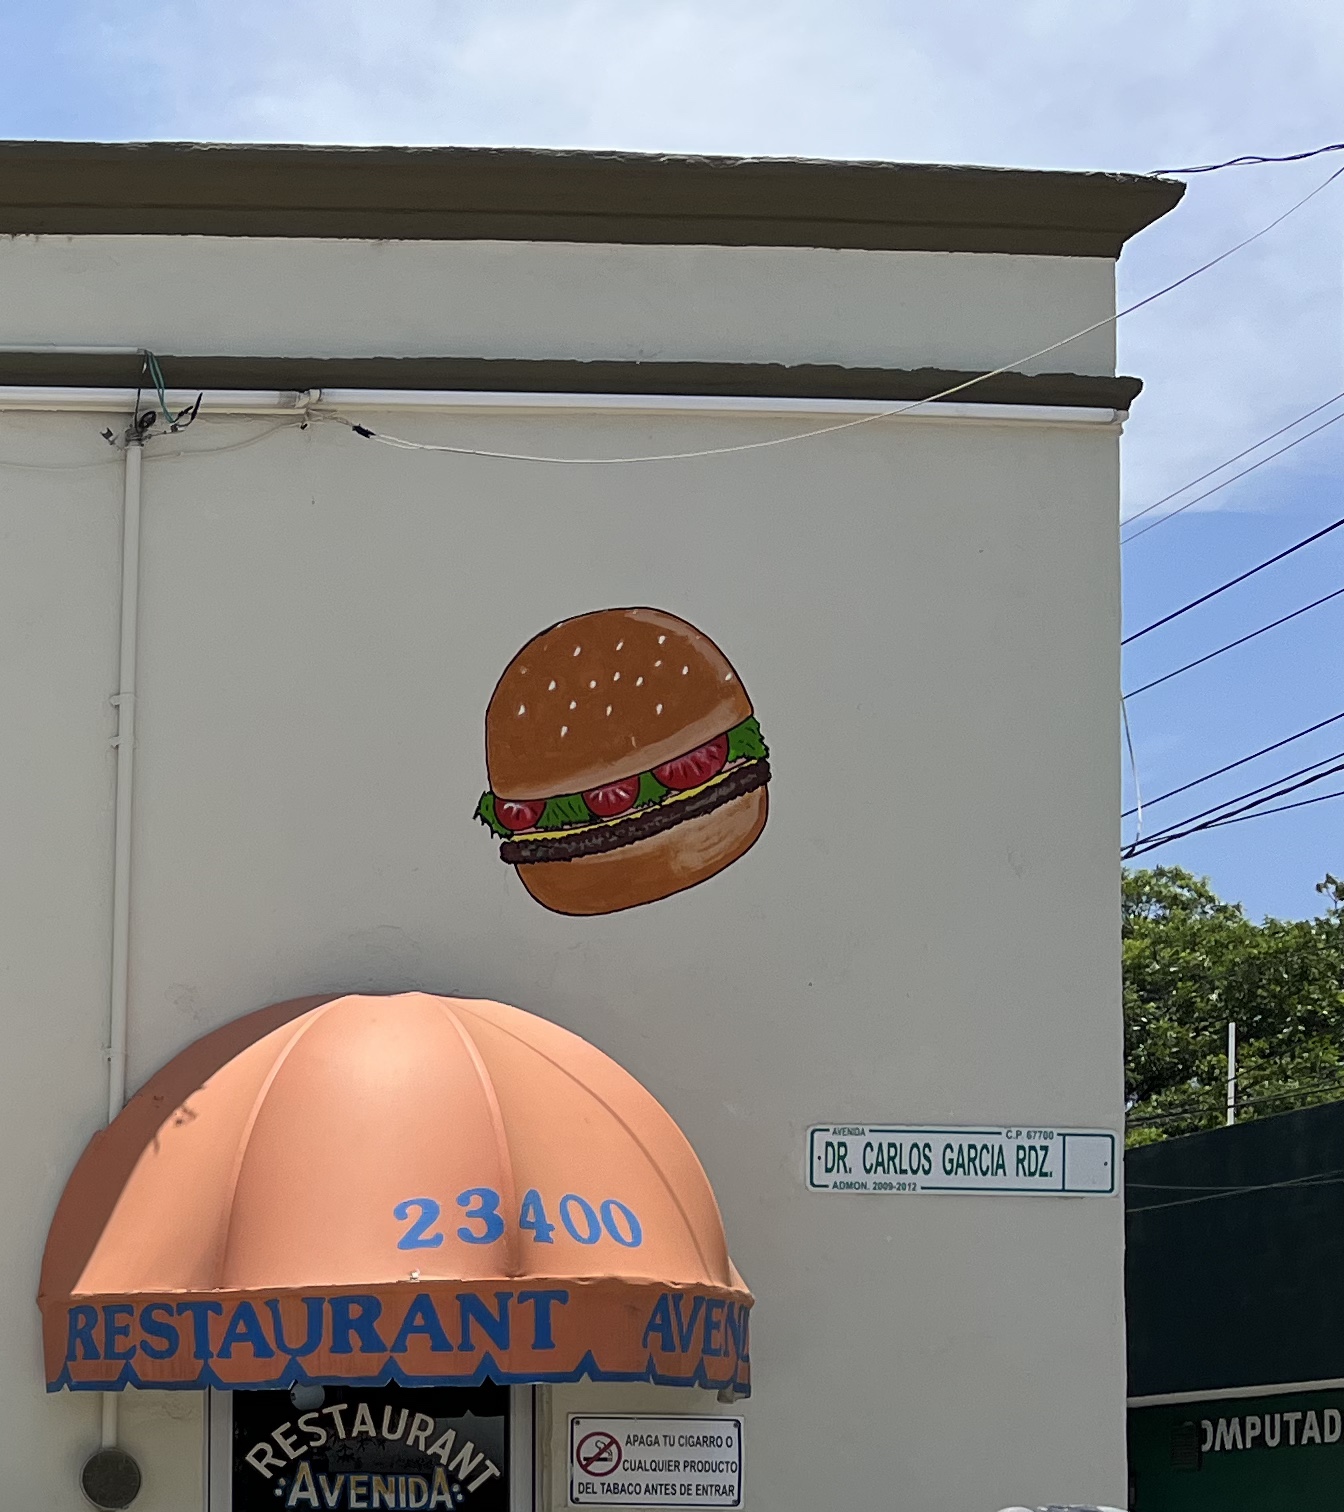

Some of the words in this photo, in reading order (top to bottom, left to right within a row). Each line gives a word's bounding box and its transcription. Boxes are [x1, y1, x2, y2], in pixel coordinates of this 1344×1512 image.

[831, 1127, 866, 1137] AVENIDA
[824, 1141, 853, 1174] DR.
[862, 1142, 932, 1176] CARLOS
[942, 1143, 1007, 1177] GARCIA
[1015, 1145, 1054, 1178] RDZ.
[831, 1181, 870, 1191] ADMON.
[872, 1182, 917, 1191] 2009-2012
[393, 1186, 643, 1250] 23400
[66, 1290, 569, 1360] RESTAURANT
[245, 1403, 501, 1493] RESTAURANT
[625, 1434, 660, 1447] APAGA
[663, 1435, 675, 1447] TU
[678, 1435, 723, 1448] CIGARRO
[725, 1436, 733, 1448] O
[622, 1459, 680, 1473] CUALQUIER
[683, 1460, 738, 1473] PRODUCTO
[287, 1461, 454, 1510] AVENIDA
[578, 1482, 597, 1494] DEL
[600, 1482, 641, 1495] TABACO
[644, 1483, 676, 1495] ANTES
[679, 1484, 693, 1495] DE
[696, 1484, 735, 1497] ENTRAR
